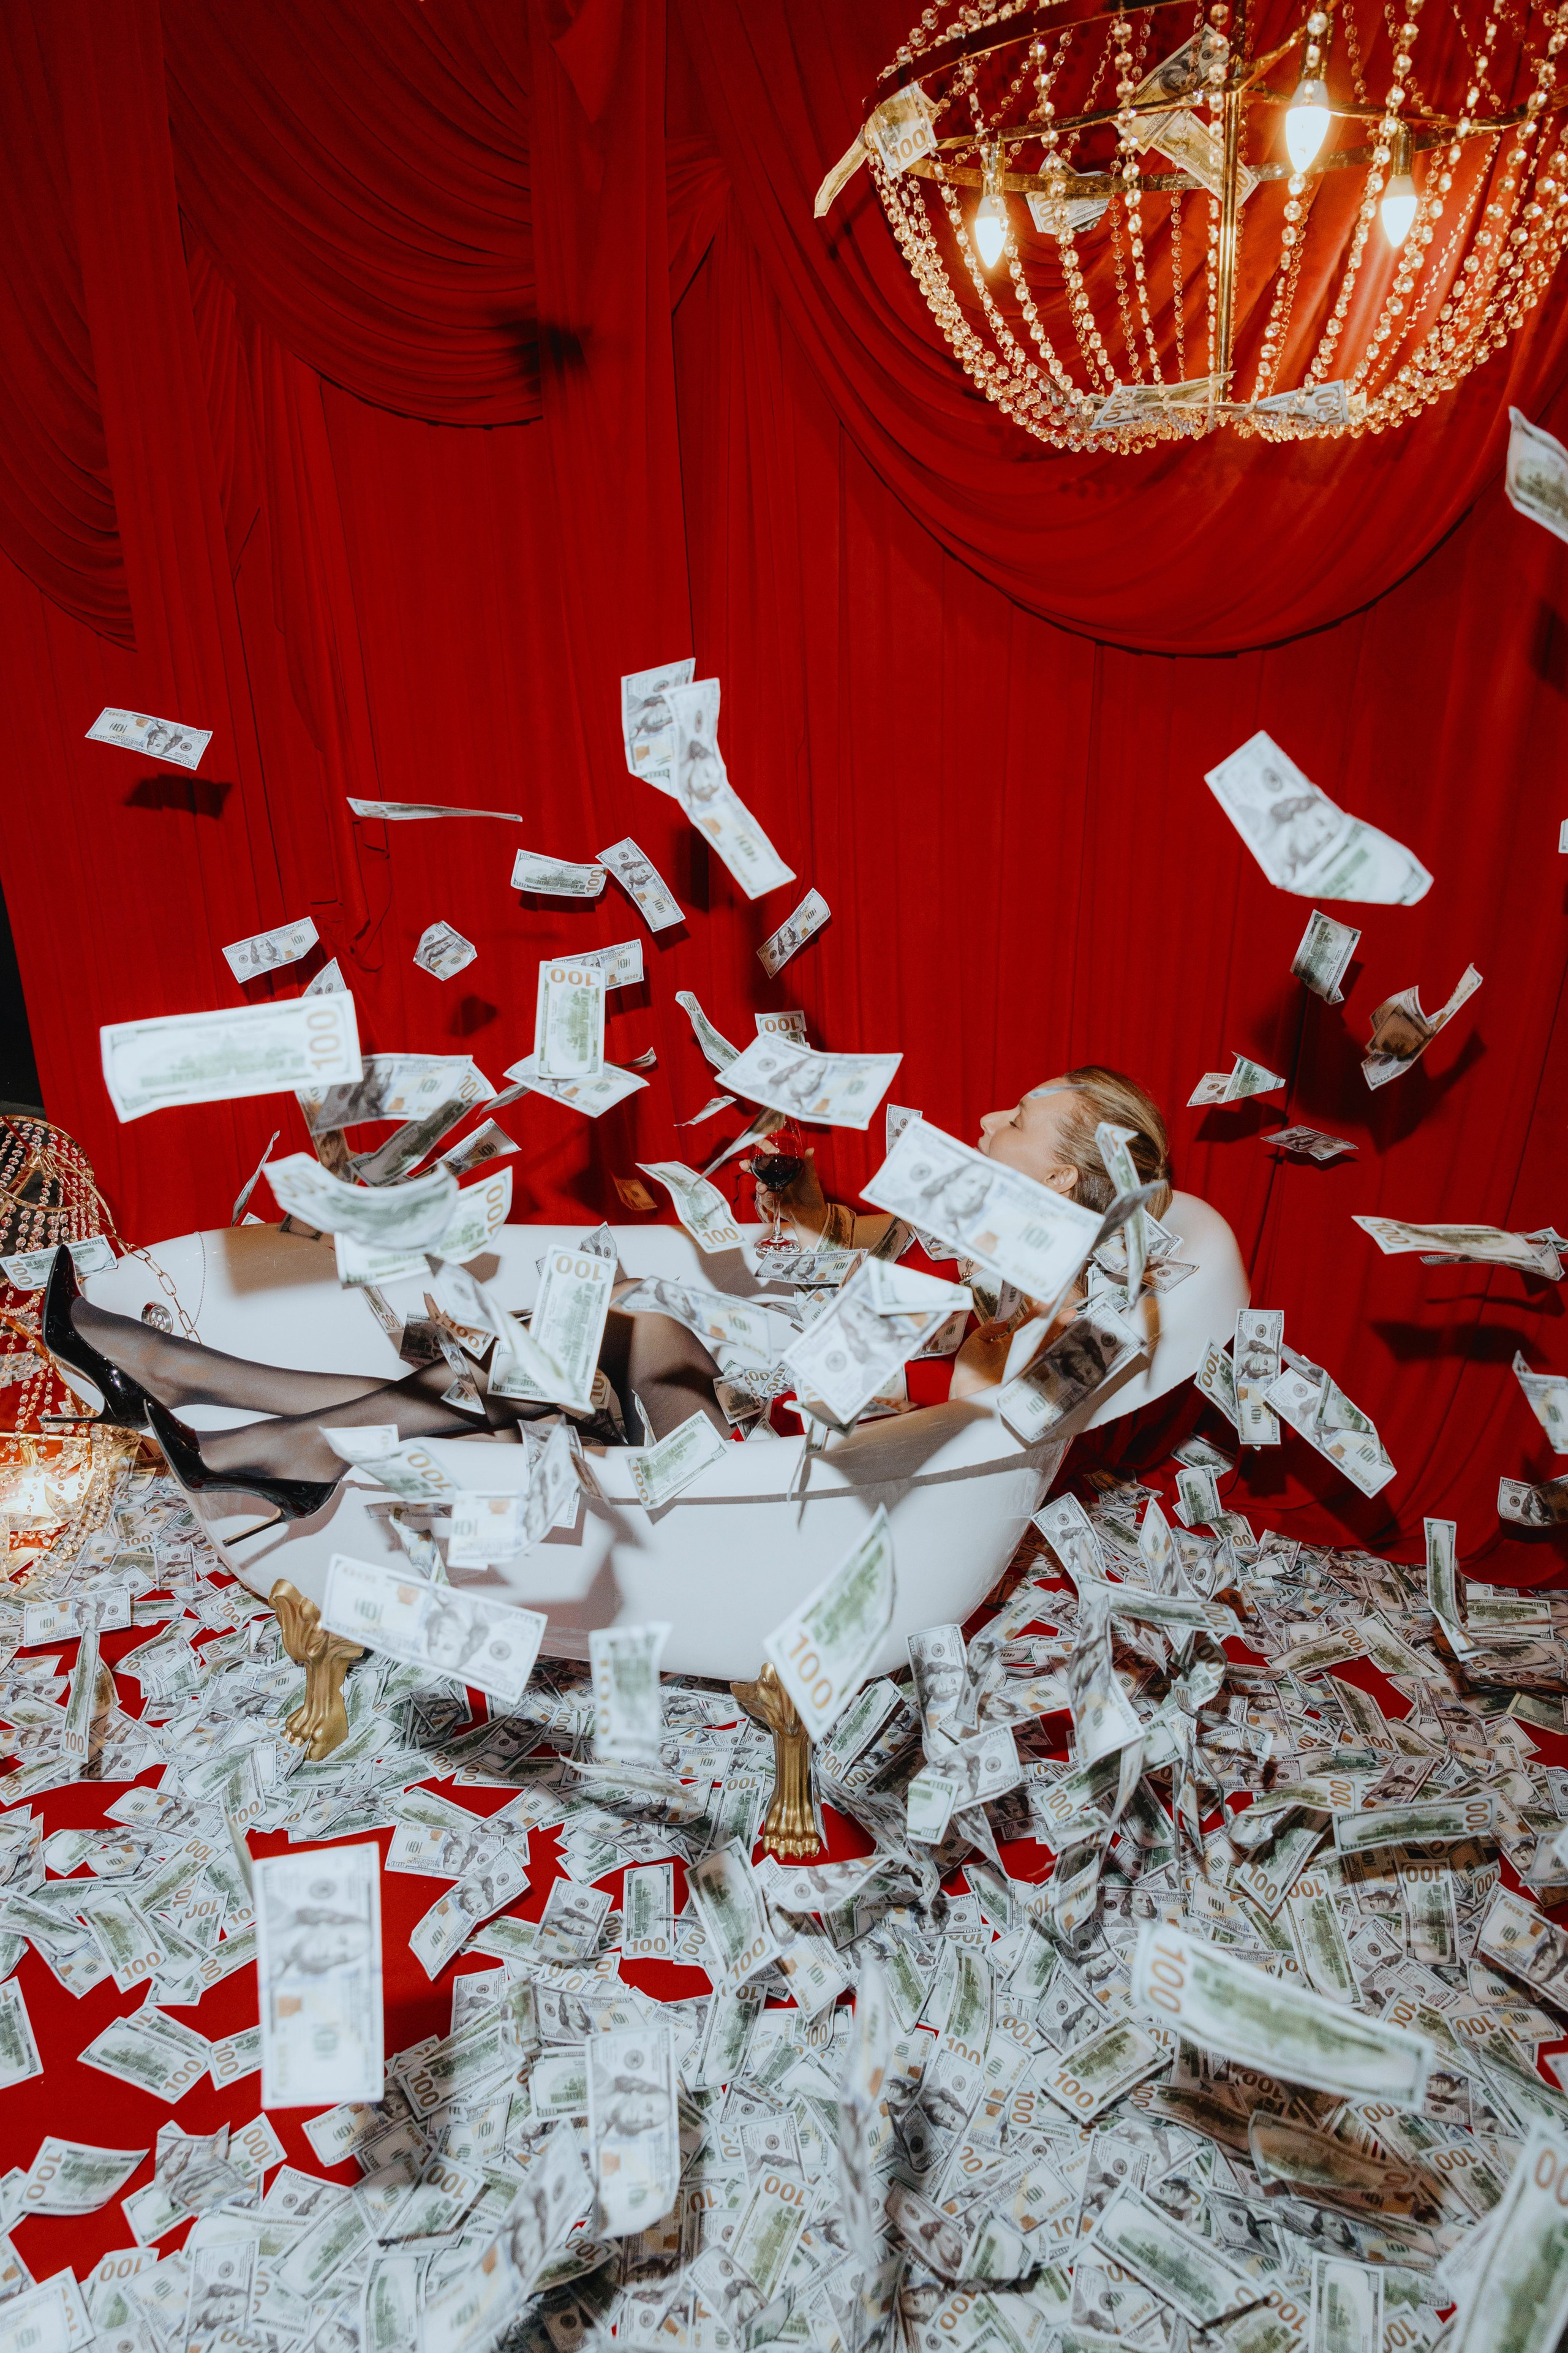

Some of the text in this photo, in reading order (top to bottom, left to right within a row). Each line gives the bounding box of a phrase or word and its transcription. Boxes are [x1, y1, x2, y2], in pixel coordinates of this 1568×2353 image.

[586, 869, 602, 893] 100
[551, 969, 595, 987] 100
[764, 1017, 799, 1032] 100
[307, 1010, 341, 1070] 100
[487, 1185, 503, 1235] 100
[702, 1227, 739, 1245] 100
[9, 1261, 33, 1285] 100
[556, 1256, 604, 1282] 100
[381, 1313, 401, 1328] 100
[452, 1324, 479, 1348] 100
[1202, 1351, 1219, 1388] 100
[407, 1453, 452, 1490] 100
[633, 1462, 650, 1502] 100
[124, 1536, 151, 1546] 100
[1046, 1559, 1058, 1576] 100
[220, 1603, 240, 1622] 100
[1202, 1603, 1231, 1628] 100
[205, 1644, 223, 1658] 100
[1341, 1629, 1365, 1652] 100
[123, 1660, 141, 1671] 10
[789, 1634, 832, 1709] 100
[553, 1712, 572, 1733] 100
[65, 1731, 84, 1753] 100
[1362, 1734, 1393, 1751] 100
[431, 1753, 454, 1772] 100
[821, 1751, 843, 1777] 100
[0, 1778, 22, 1797] 100
[727, 1777, 758, 1791] 100
[844, 1768, 873, 1787] 100
[1047, 1788, 1073, 1819] 100
[1329, 1780, 1351, 1808] 100
[232, 1801, 259, 1824] 100
[1466, 1802, 1488, 1830] 100
[185, 1840, 214, 1860] 100
[1248, 1864, 1277, 1902] 100
[1406, 1868, 1443, 1883] 100
[1288, 1878, 1324, 1898] 100
[228, 1904, 257, 1925] 10
[1027, 1894, 1051, 1916] 100
[603, 1917, 622, 1943] 100
[630, 1938, 666, 1953] 100
[123, 1952, 162, 1981] 100
[731, 1938, 765, 1979] 100
[1149, 1946, 1188, 2014] 100
[805, 2024, 827, 2046] 100
[1003, 2017, 1036, 2048] 100
[1456, 2015, 1496, 2036] 100
[214, 2043, 239, 2076] 100
[164, 2060, 202, 2091] 100
[411, 2071, 440, 2107] 100
[1054, 2071, 1093, 2107] 100
[1011, 2090, 1034, 2123] 100
[243, 2128, 273, 2165] 100
[1434, 2147, 1477, 2170] 100
[27, 2153, 61, 2199] 100
[426, 2164, 468, 2198] 100
[764, 2176, 804, 2206] 100
[100, 2257, 143, 2281] 100
